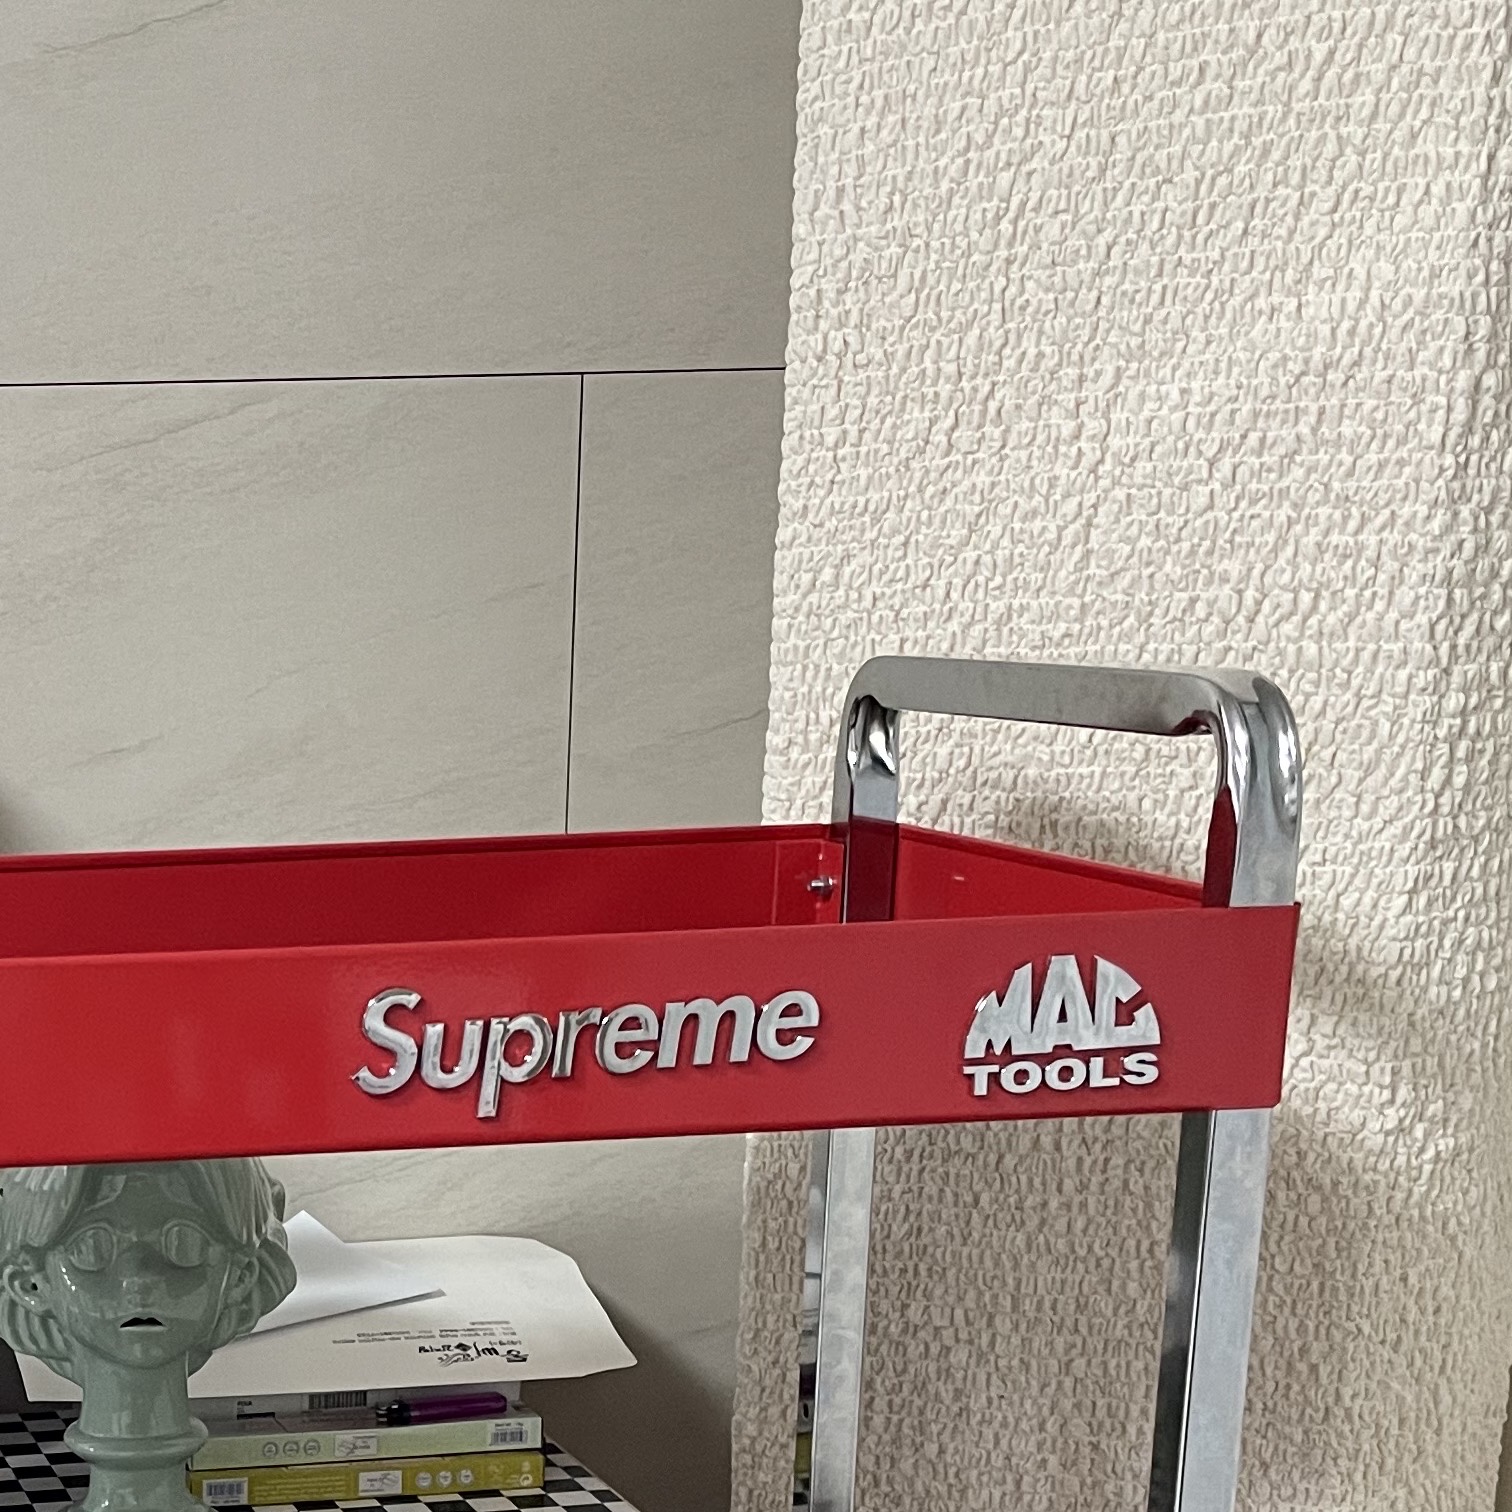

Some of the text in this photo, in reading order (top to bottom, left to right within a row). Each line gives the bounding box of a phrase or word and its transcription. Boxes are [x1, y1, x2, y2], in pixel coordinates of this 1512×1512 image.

[351, 987, 820, 1119] Supreme
[964, 954, 1161, 1060] MAC
[963, 1052, 1160, 1096] TOOLS
